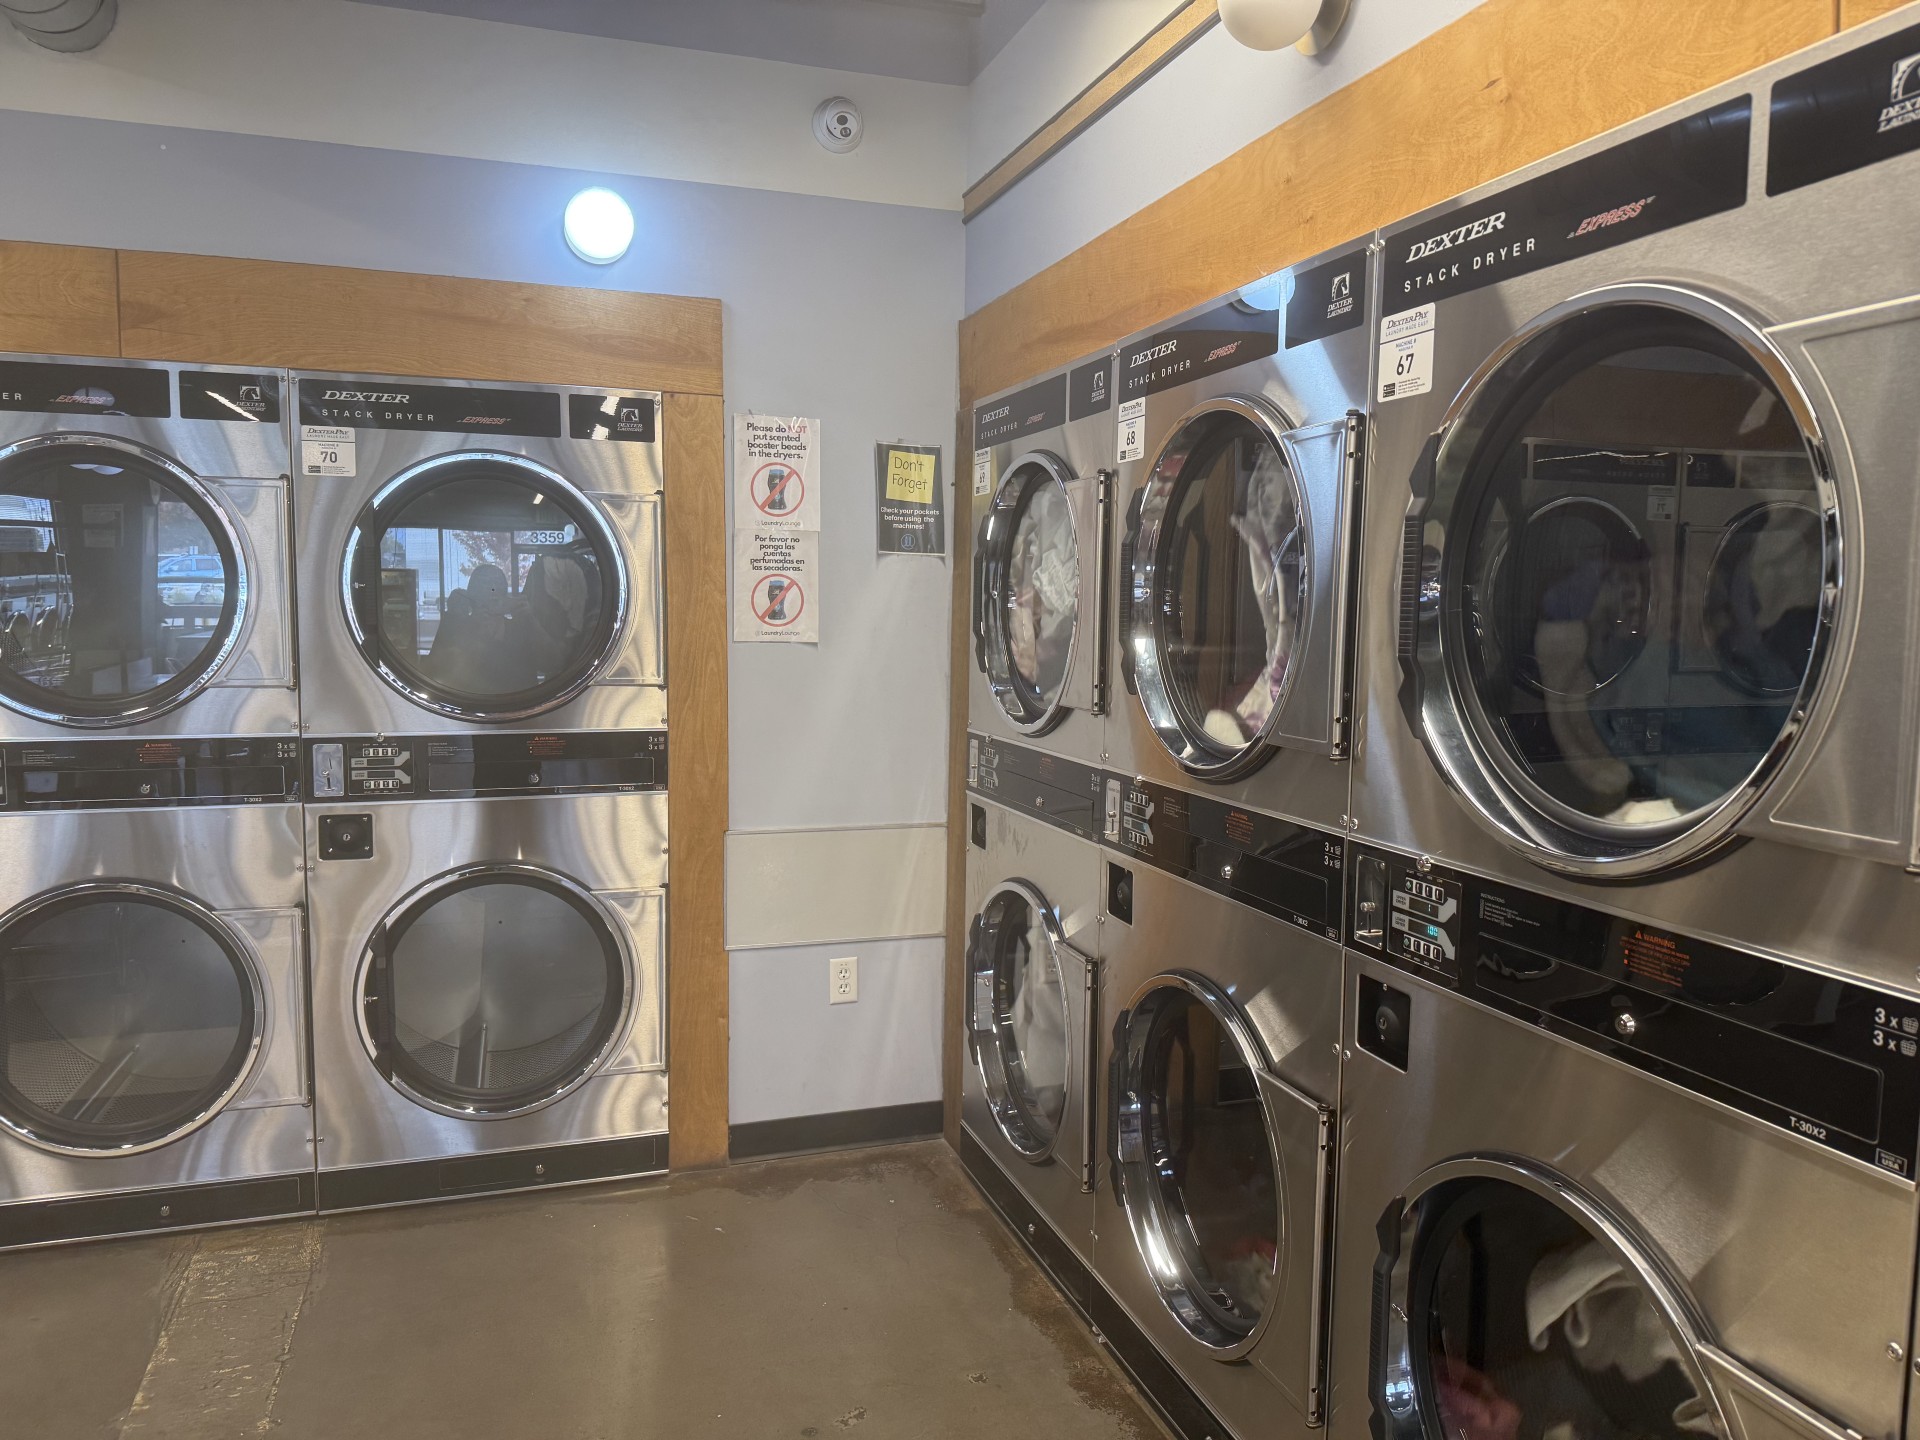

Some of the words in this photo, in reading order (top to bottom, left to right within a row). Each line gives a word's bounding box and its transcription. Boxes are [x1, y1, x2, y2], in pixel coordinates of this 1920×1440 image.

[1878, 95, 1920, 121] DEXT
[1876, 108, 1920, 133] LAUN
[1575, 198, 1646, 236] EXPRESS
[1405, 211, 1506, 264] DEXTER
[1404, 263, 1459, 293] STACK
[1473, 237, 1535, 270] DRYER
[1326, 304, 1353, 319] LAUNDRY
[1327, 297, 1353, 312] DEXTER
[1385, 326, 1405, 337] LAUNDRY
[1405, 323, 1417, 332] MADE
[1418, 320, 1429, 328] EASY
[1129, 339, 1177, 368] DEXTER
[1396, 353, 1414, 376] 67
[1128, 371, 1156, 389] STACK
[1161, 359, 1190, 378] DRYER
[322, 390, 410, 404] DEXTER
[322, 408, 373, 419] STACK
[385, 412, 434, 422] DRYER
[462, 416, 507, 426] EXPRESS
[981, 406, 1010, 424] DEXTER
[747, 422, 774, 433] Please
[775, 424, 786, 434] do
[788, 425, 808, 434] NOT
[980, 428, 998, 440] STACK
[1000, 422, 1018, 434] DRYER
[747, 440, 780, 449] booster
[781, 442, 807, 451] beads
[753, 434, 768, 442] put
[769, 434, 800, 442] scented
[1126, 430, 1136, 446] 68
[320, 450, 338, 464] 70
[748, 448, 756, 457] in
[758, 448, 772, 458] the
[773, 451, 804, 460] dryers.
[894, 456, 924, 472] Don't
[892, 474, 928, 494] Forget
[979, 471, 986, 484] 69
[914, 508, 940, 516] pockets
[530, 532, 565, 544] 3359
[754, 534, 768, 542] Por
[769, 535, 789, 543] favor
[750, 557, 794, 565] perfumadas
[764, 564, 803, 572] secadoras.
[1324, 842, 1329, 852] 3
[1324, 855, 1329, 865] 3
[1644, 933, 1676, 949] WARNING
[1874, 1007, 1886, 1024] 3
[1890, 1016, 1898, 1029] x
[1872, 1030, 1884, 1046] 3
[1888, 1039, 1896, 1052] x
[1789, 1115, 1826, 1140] T-30X2
[1882, 1158, 1900, 1170] USA
